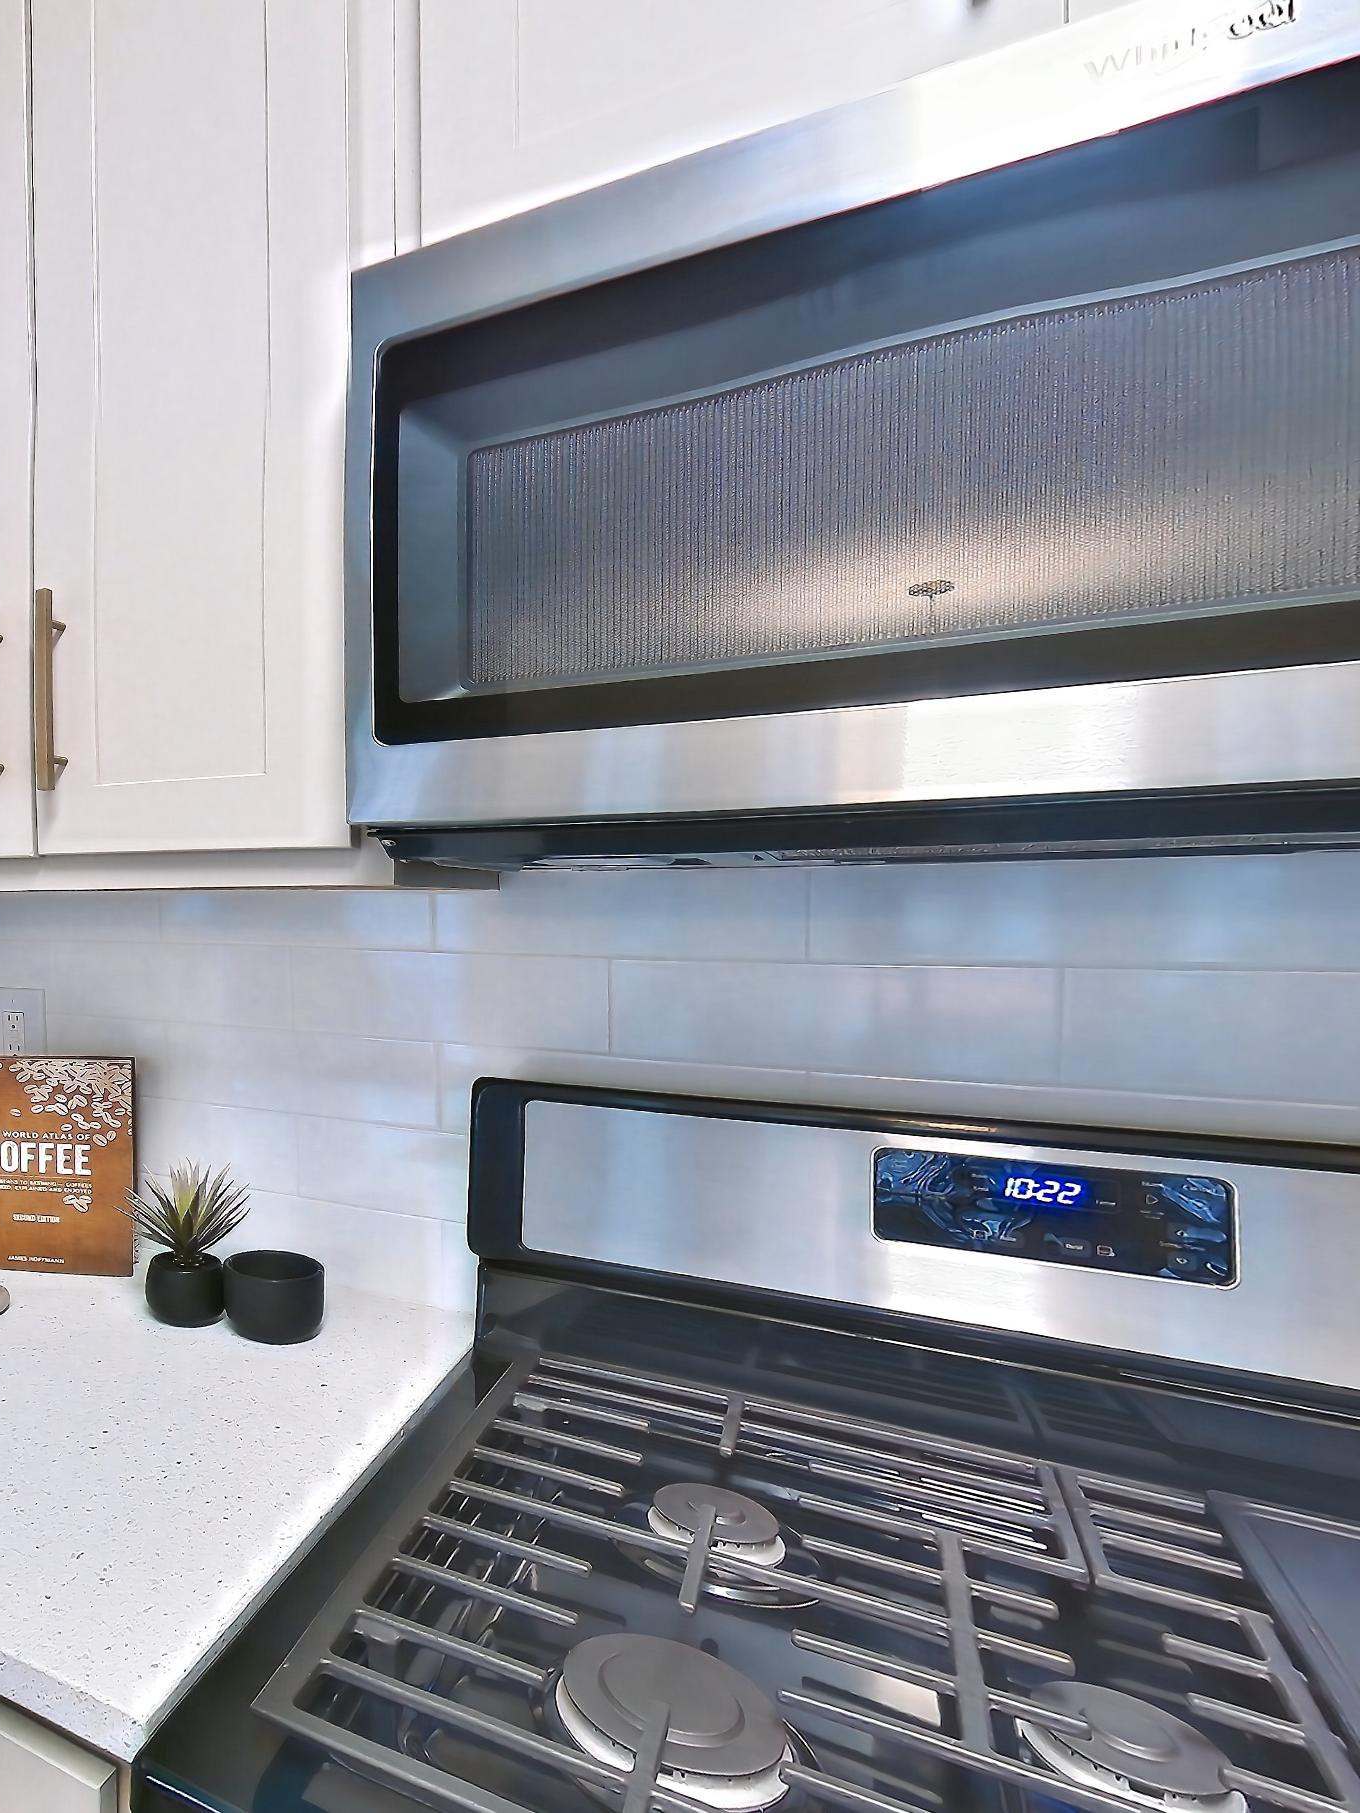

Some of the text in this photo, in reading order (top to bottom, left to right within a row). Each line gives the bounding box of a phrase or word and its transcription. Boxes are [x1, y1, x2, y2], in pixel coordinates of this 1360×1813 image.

[3, 1131, 39, 1139] WORLD
[42, 1132, 73, 1140] ATLAS
[76, 1133, 91, 1141] OF
[1004, 1177, 1082, 1205] 10:22
